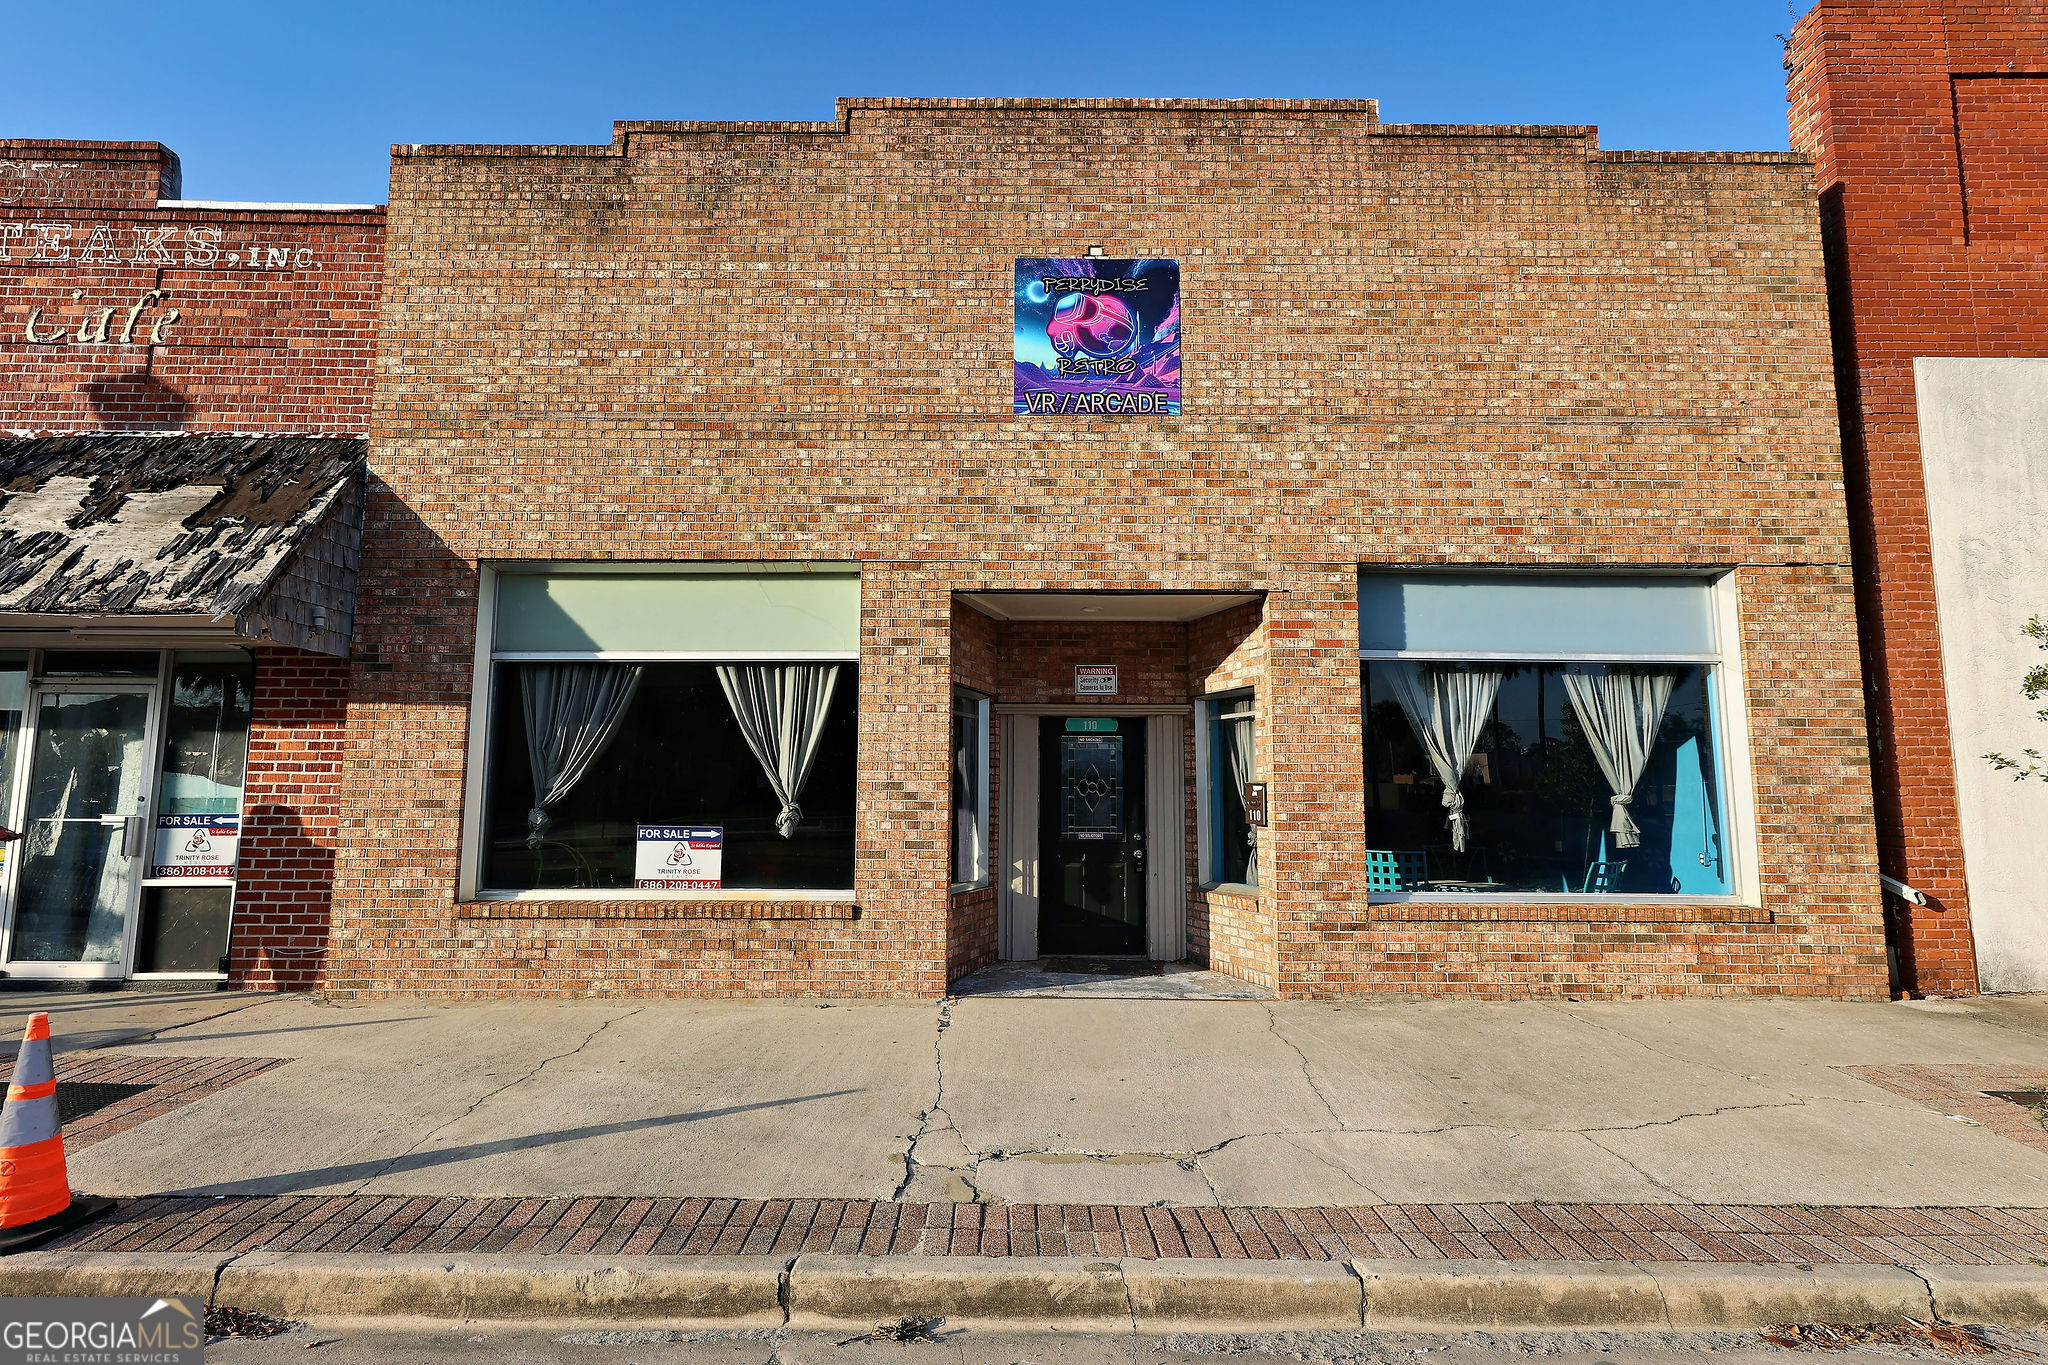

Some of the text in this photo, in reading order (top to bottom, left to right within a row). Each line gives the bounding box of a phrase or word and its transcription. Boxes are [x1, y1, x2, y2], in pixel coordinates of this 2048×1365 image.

[247, 246, 323, 268] INC.
[1057, 358, 1138, 375] RETRO
[1025, 393, 1056, 413] VR
[1074, 393, 1168, 413] ARCADE
[1083, 721, 1098, 730] 110
[1249, 810, 1261, 820] 110
[159, 817, 211, 825] FOR SALE
[640, 829, 690, 838] FOR SALE
[155, 866, 235, 876] (386) 208-0447
[638, 880, 718, 889] (386) 208-0447
